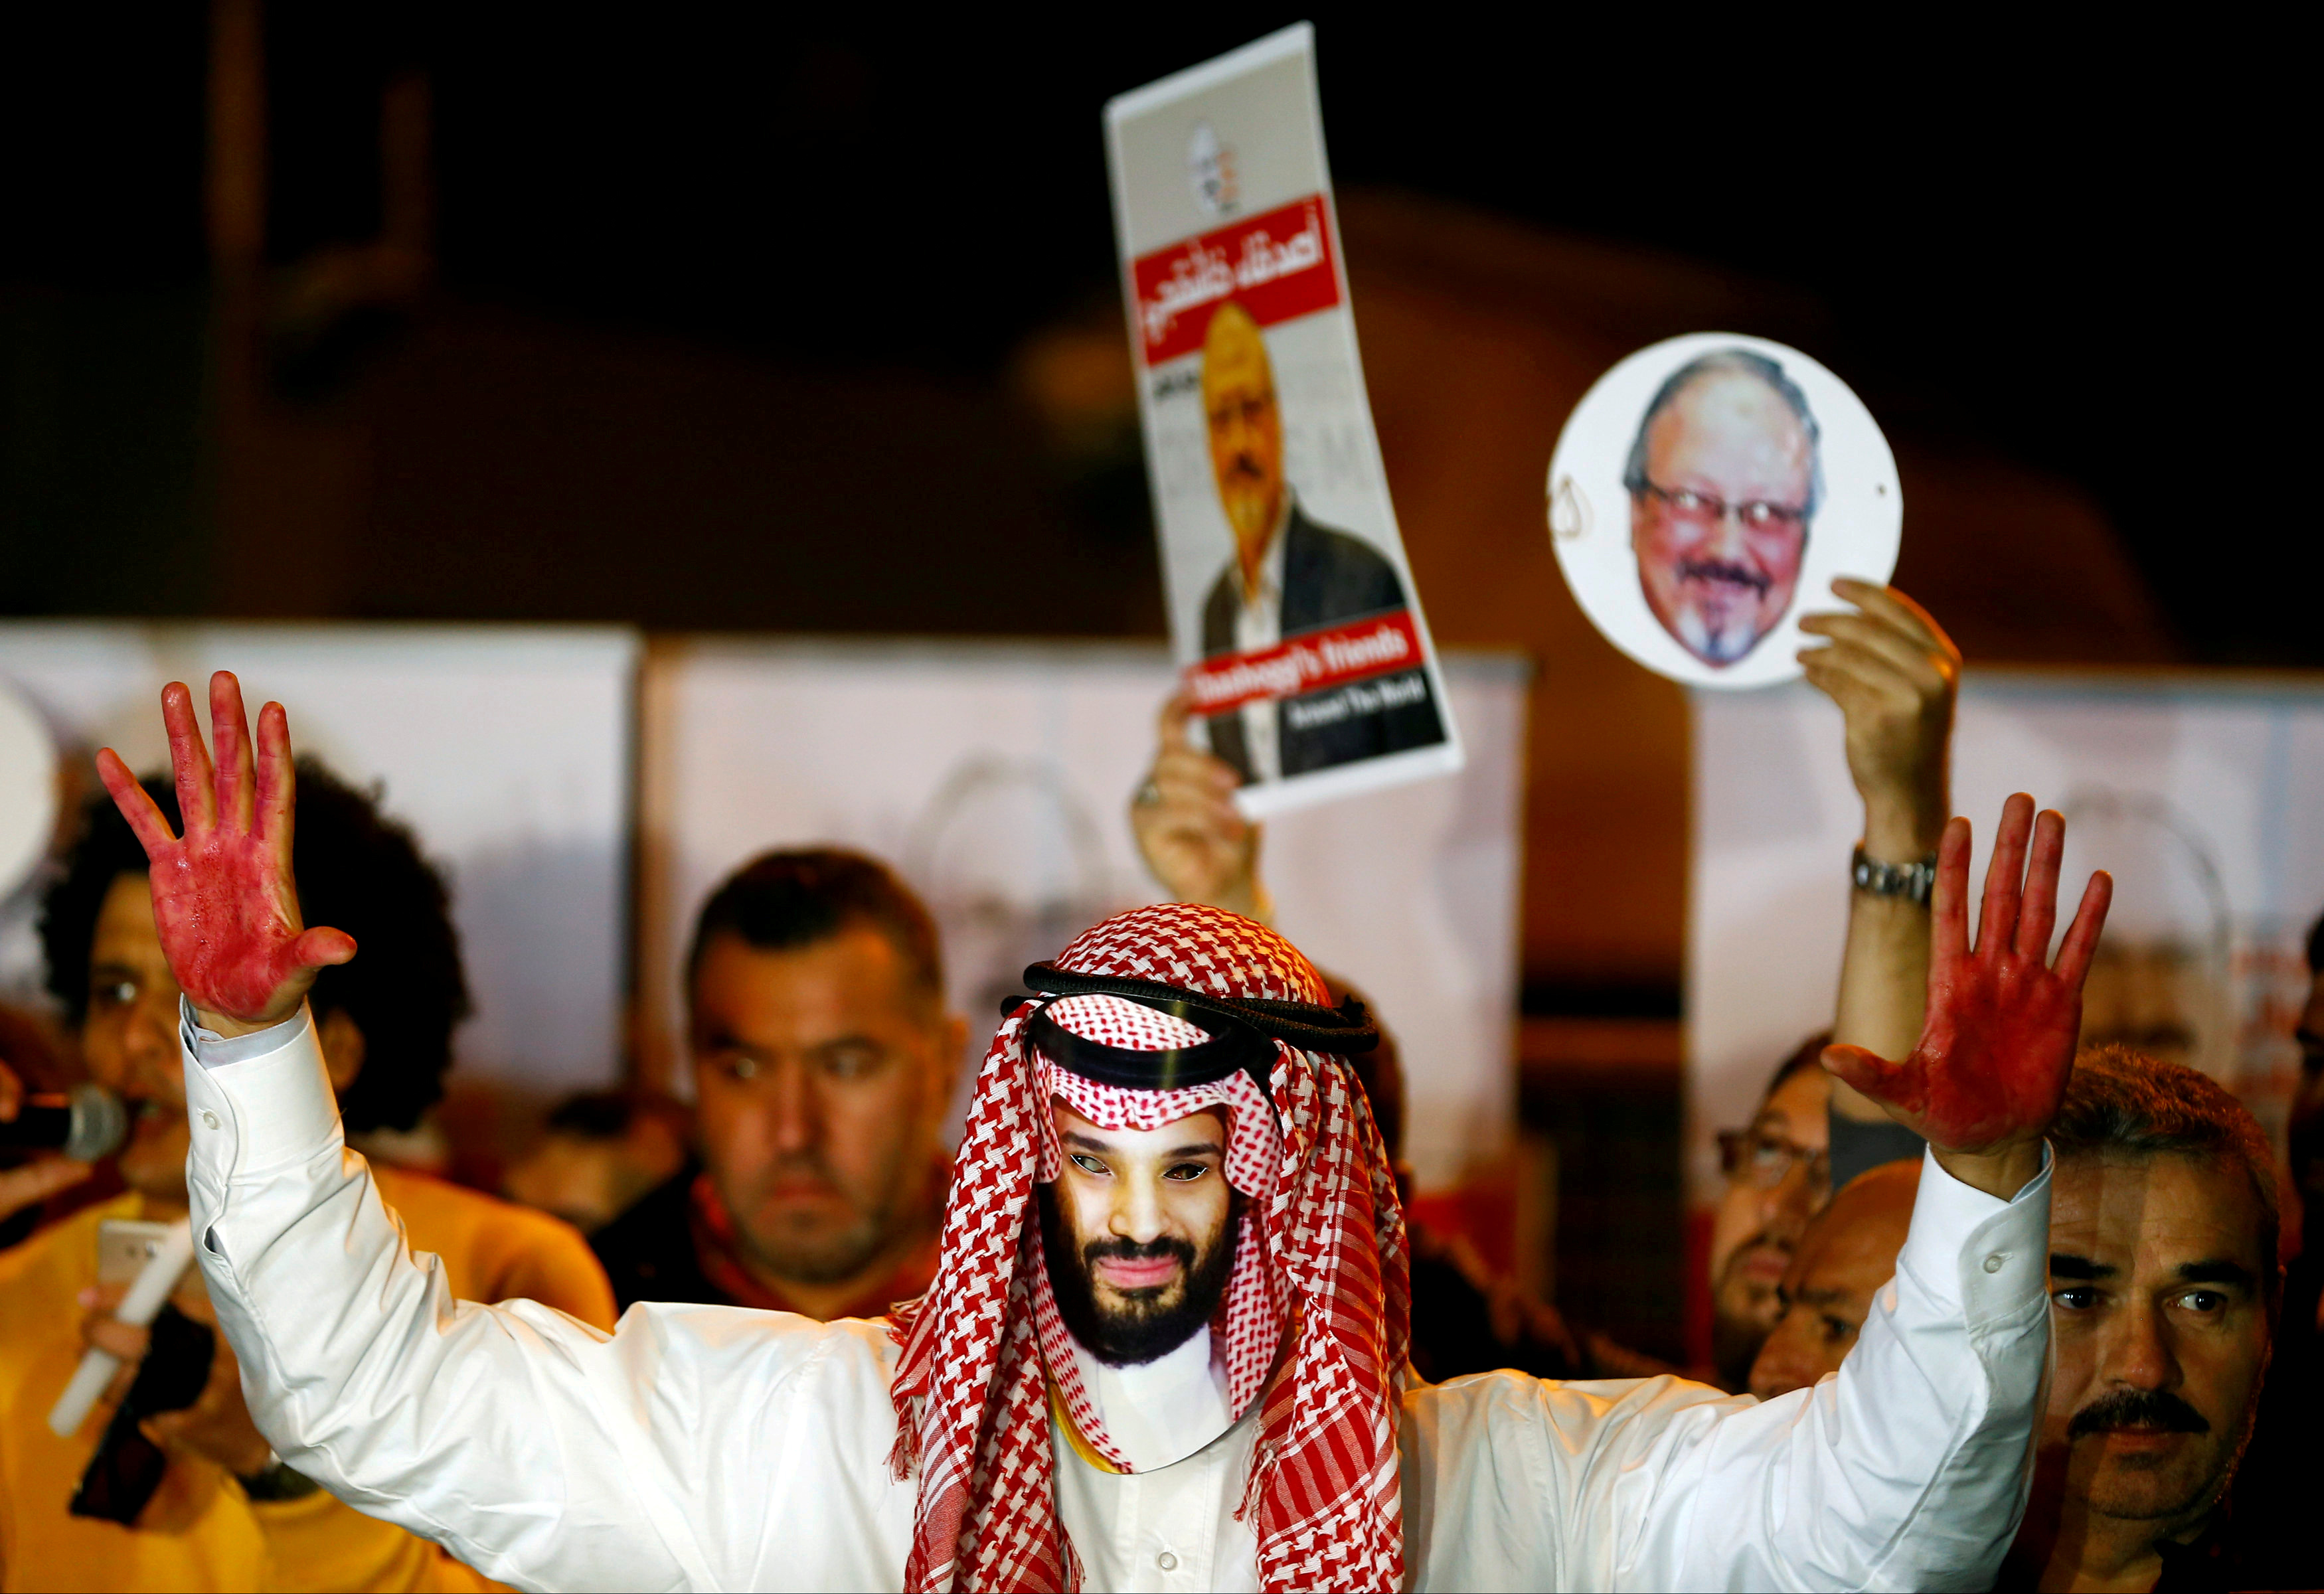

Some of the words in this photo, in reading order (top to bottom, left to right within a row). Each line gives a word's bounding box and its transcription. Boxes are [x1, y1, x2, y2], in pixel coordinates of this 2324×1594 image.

[1319, 623, 1409, 673] friends
[1287, 697, 1349, 729] Around
[1345, 684, 1381, 716] The
[1379, 672, 1426, 708] World
